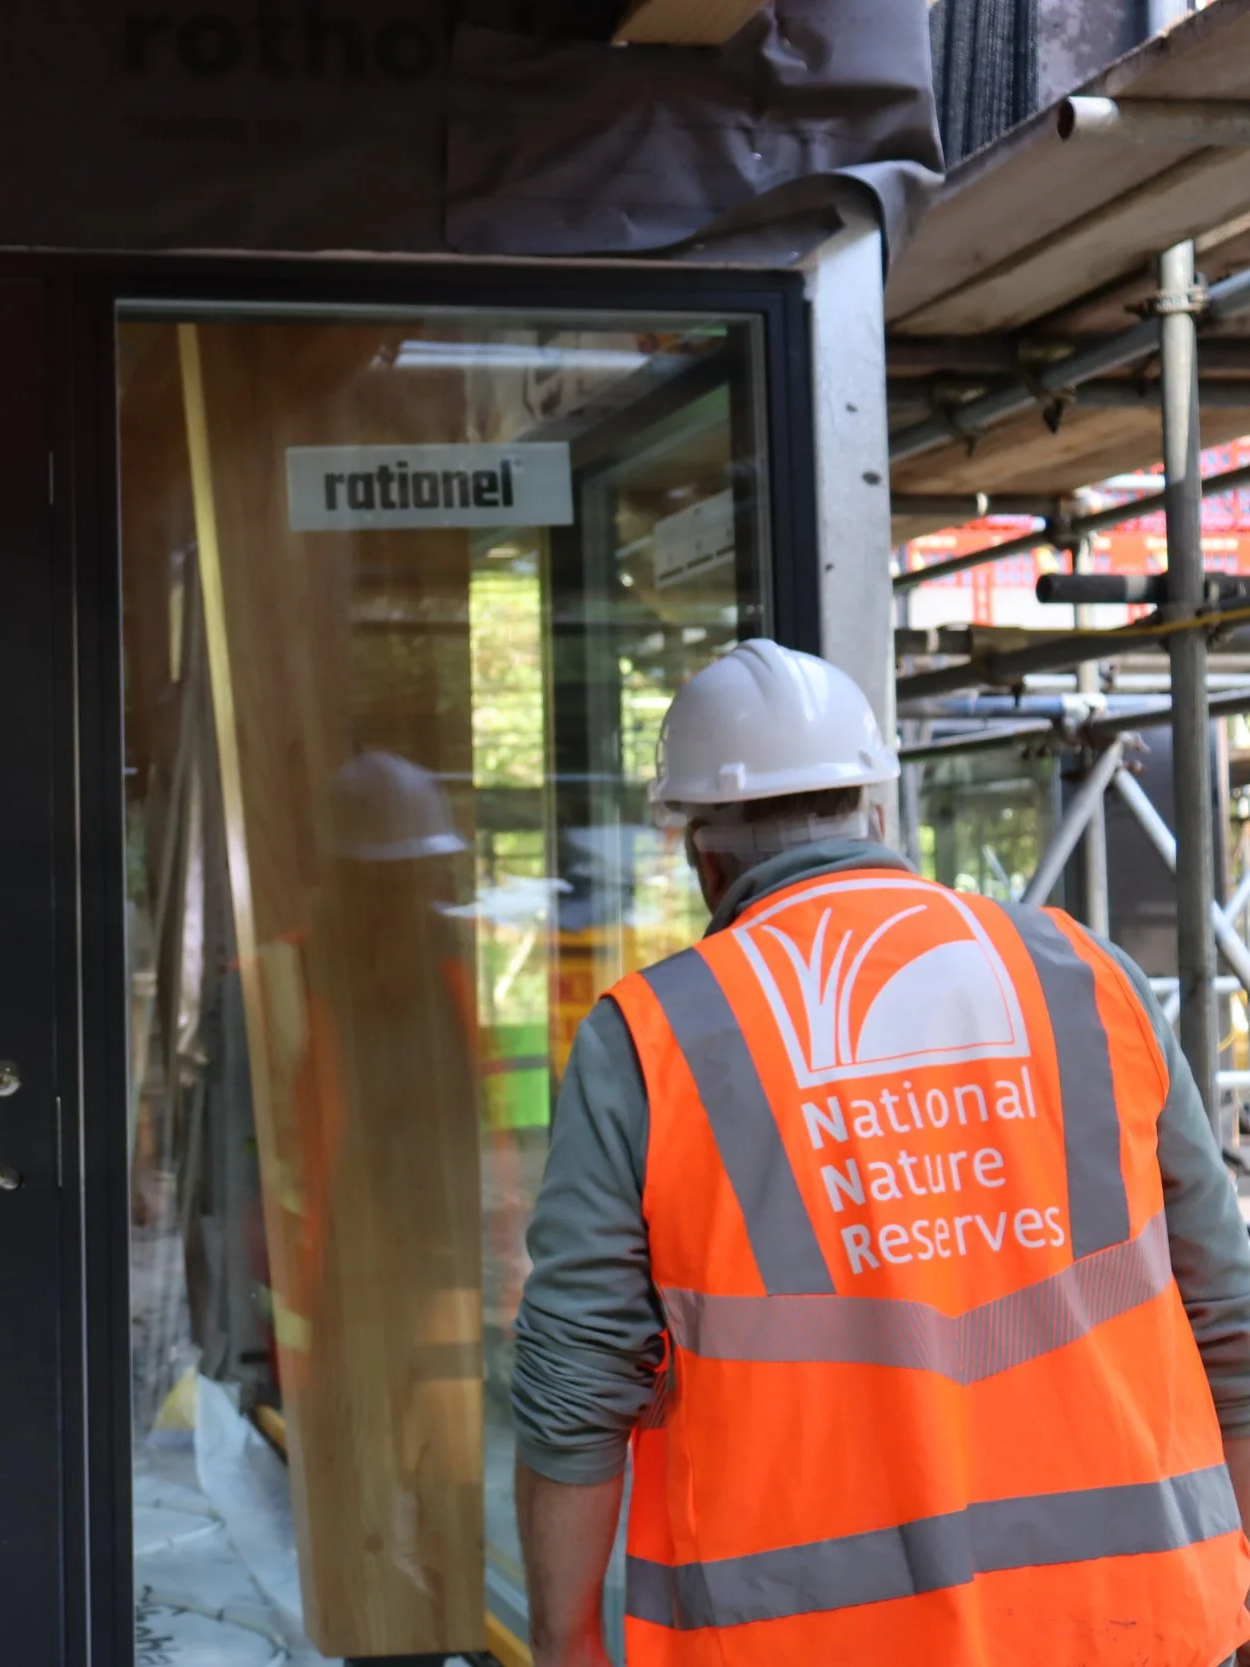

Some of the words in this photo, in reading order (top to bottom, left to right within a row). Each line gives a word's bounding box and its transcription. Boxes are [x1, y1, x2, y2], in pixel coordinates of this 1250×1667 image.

[324, 459, 514, 511] rationel
[801, 1065, 1037, 1150] National
[820, 1146, 1007, 1213] Nature
[840, 1205, 1065, 1275] Reserves
